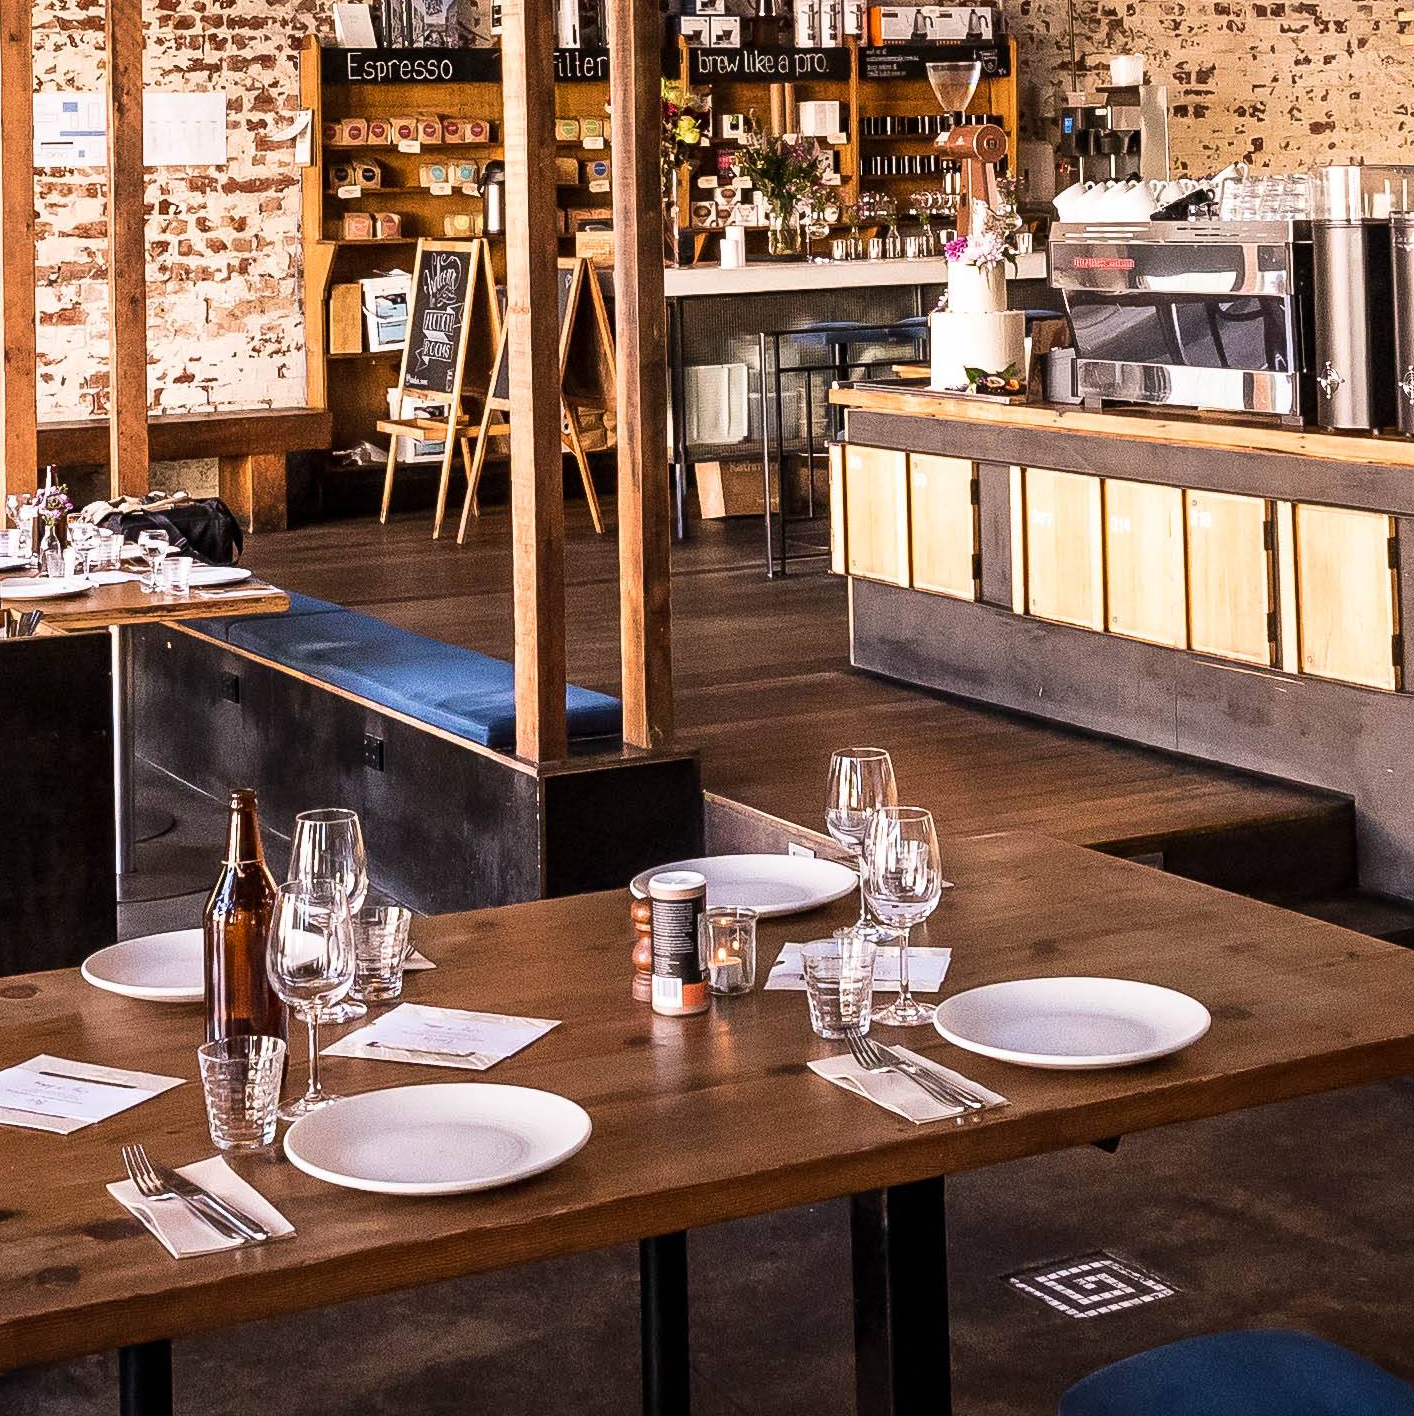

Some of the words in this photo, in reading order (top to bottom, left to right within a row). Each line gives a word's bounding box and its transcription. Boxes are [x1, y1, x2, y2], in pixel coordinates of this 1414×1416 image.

[347, 52, 453, 82] Espresso
[697, 50, 739, 73] brew
[743, 50, 775, 73] like
[778, 54, 789, 73] a
[794, 53, 830, 77] pro.
